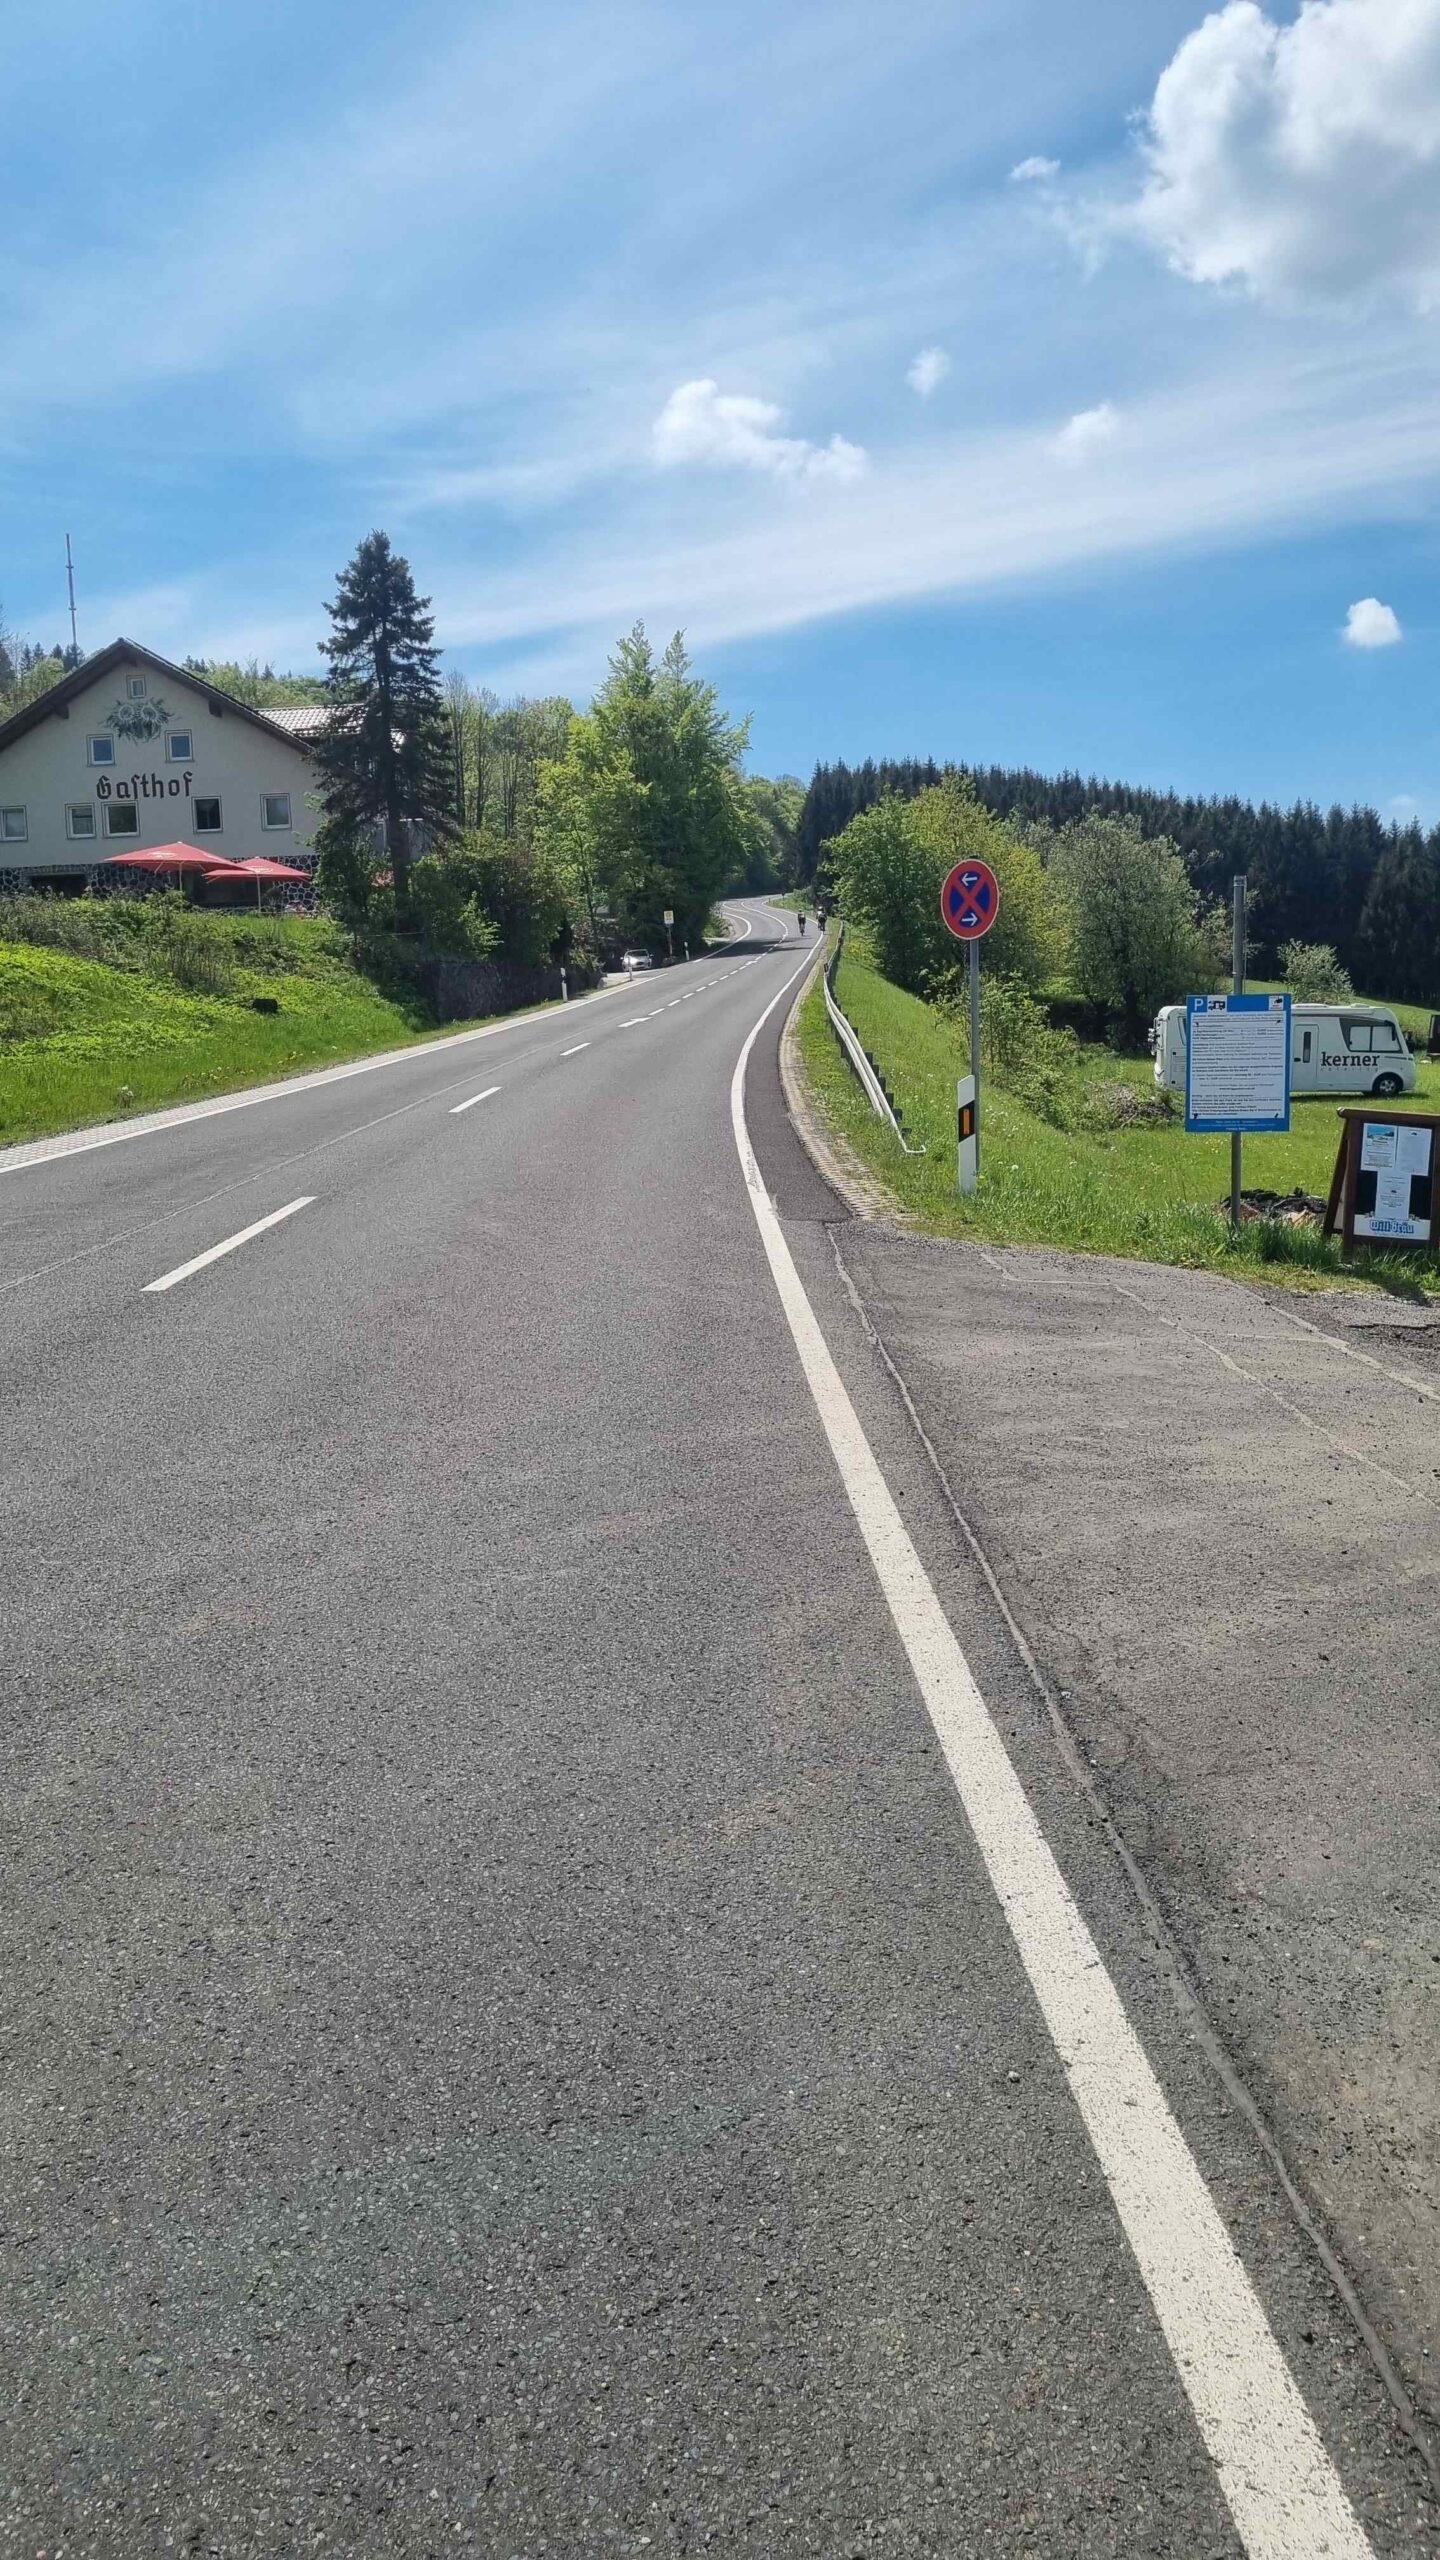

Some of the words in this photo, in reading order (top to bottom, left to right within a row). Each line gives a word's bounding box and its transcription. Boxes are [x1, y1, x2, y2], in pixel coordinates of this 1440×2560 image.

[96, 771, 193, 799] Gasthof
[1194, 998, 1204, 1011] P
[1320, 1051, 1380, 1067] kerner
